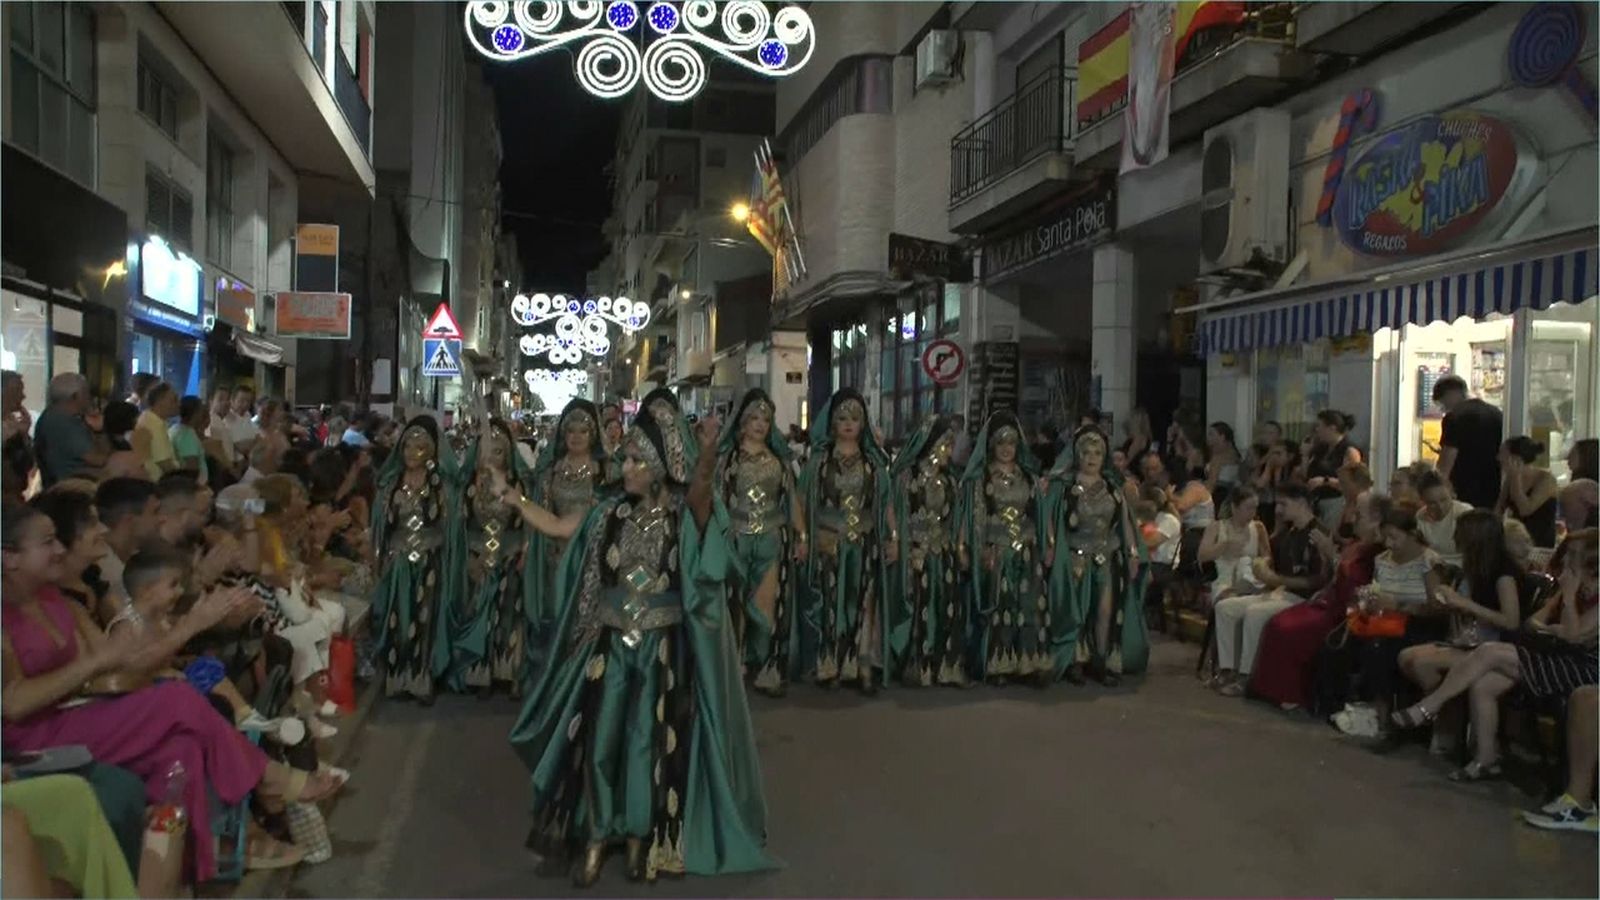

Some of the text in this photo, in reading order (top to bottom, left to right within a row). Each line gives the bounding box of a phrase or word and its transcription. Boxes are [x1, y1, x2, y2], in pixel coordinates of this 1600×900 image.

[1422, 152, 1490, 238] PIKA
[1039, 217, 1072, 254] Santa
[1076, 201, 1106, 239] Pola
[1363, 232, 1408, 250] REGALOS
